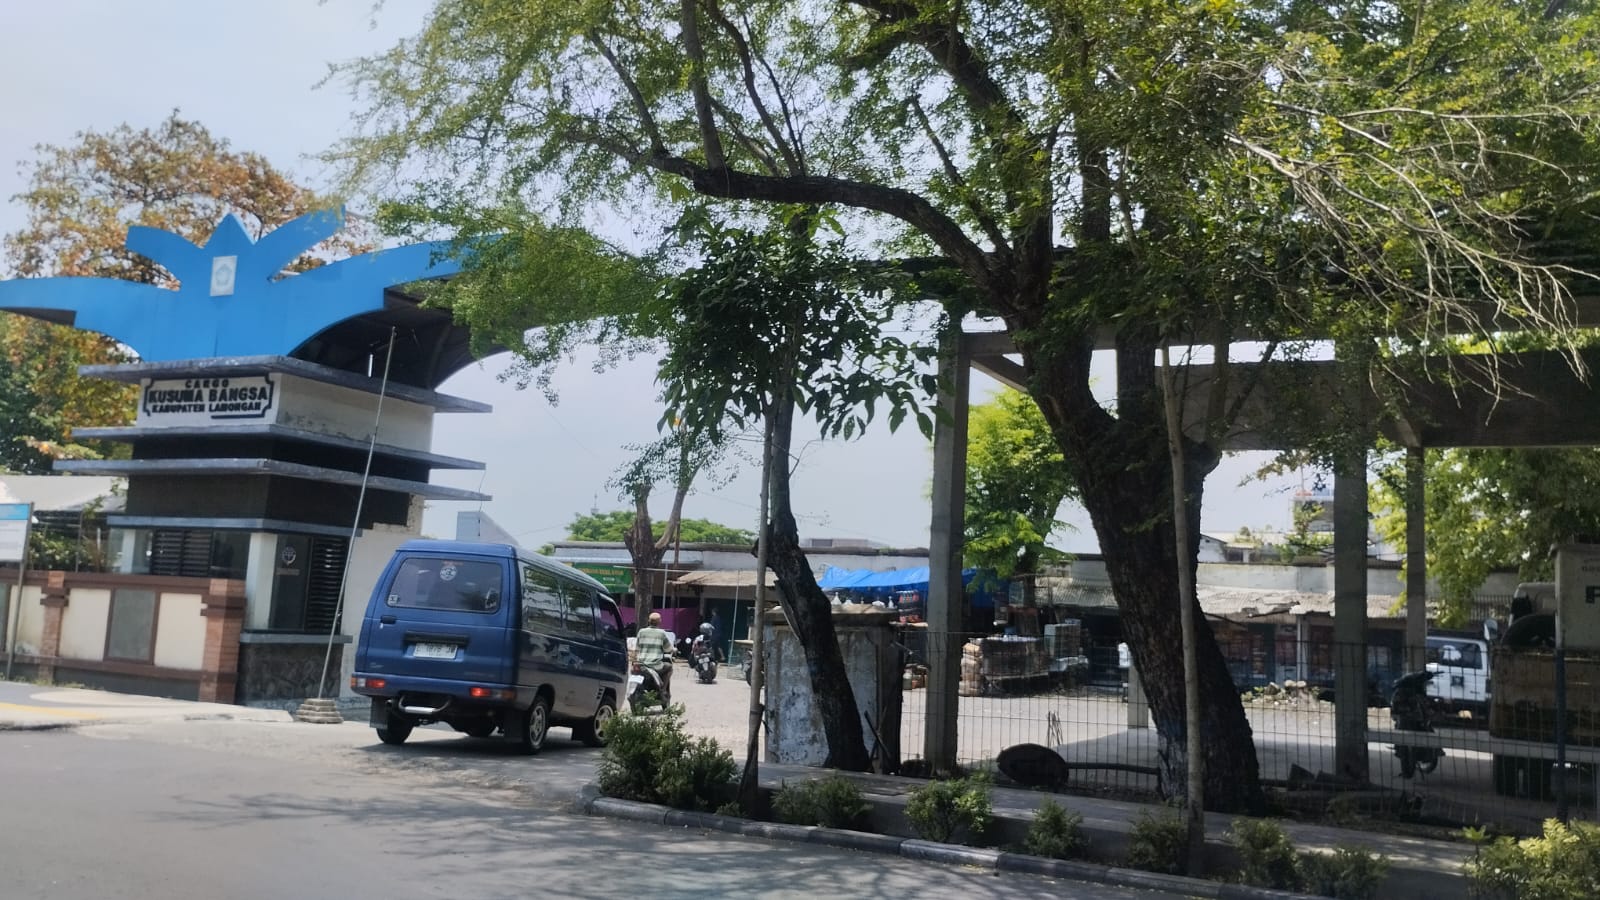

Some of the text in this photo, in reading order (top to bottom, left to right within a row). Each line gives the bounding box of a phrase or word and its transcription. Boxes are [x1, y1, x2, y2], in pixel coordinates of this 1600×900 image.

[149, 387, 268, 403] KUSUMA BANGSA
[152, 404, 205, 413] KABUPATEN
